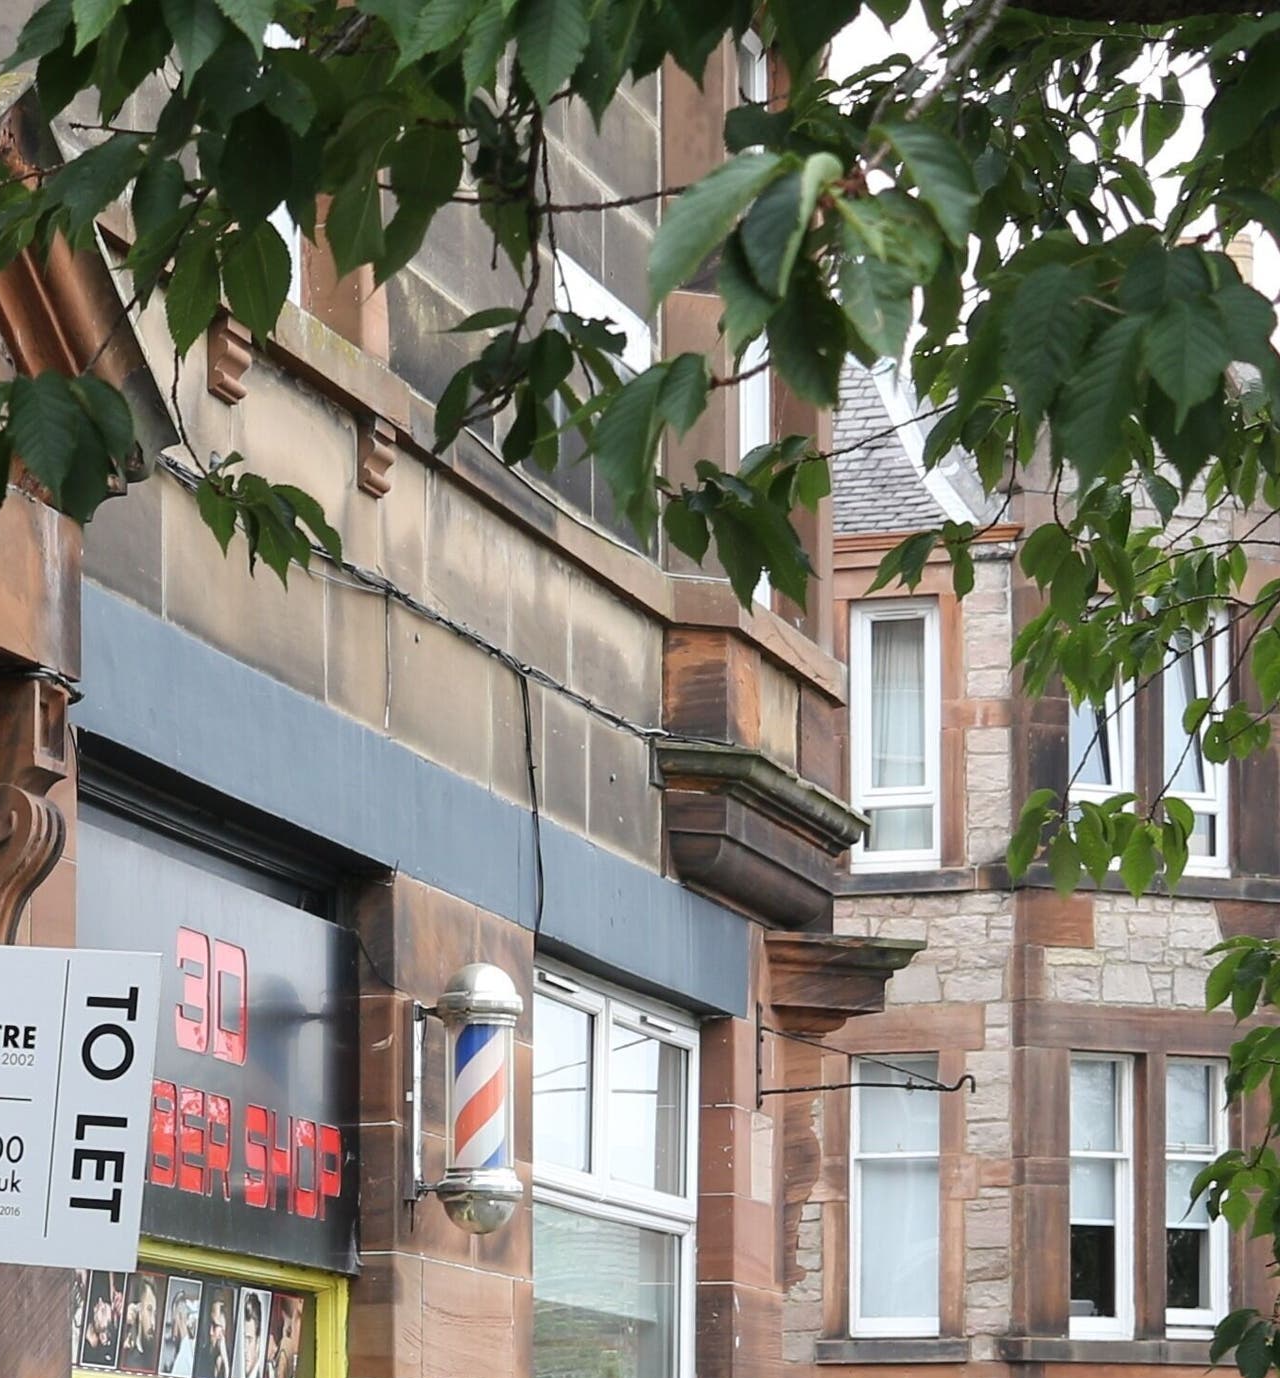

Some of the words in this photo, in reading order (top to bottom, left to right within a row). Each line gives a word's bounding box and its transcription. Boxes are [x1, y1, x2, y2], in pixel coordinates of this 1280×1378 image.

[82, 987, 139, 1080] TO
[175, 925, 248, 1065] 3D
[2, 1053, 35, 1067] 2002
[69, 1115, 128, 1223] LET
[244, 1103, 342, 1222] SHOP
